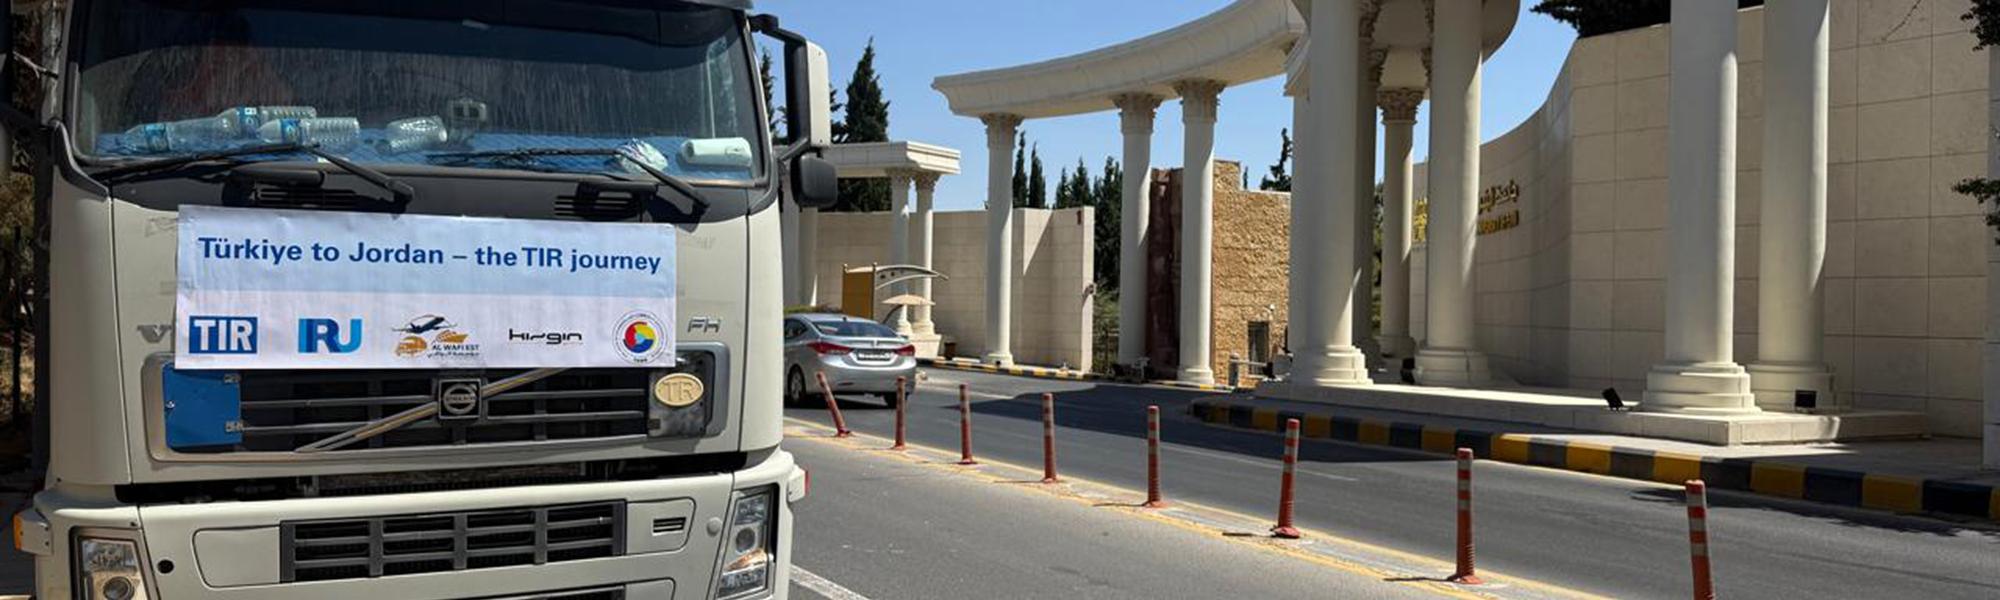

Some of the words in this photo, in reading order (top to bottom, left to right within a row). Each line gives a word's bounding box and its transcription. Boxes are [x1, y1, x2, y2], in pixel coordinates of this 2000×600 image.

[198, 237, 303, 265] Türkiye
[311, 242, 340, 262] to
[349, 242, 444, 264] Jordan
[474, 246, 518, 266] the
[521, 247, 563, 268] TIR
[570, 249, 661, 274] journey
[193, 319, 253, 351] TIR
[298, 318, 362, 353] IRU
[662, 381, 694, 401] TR
